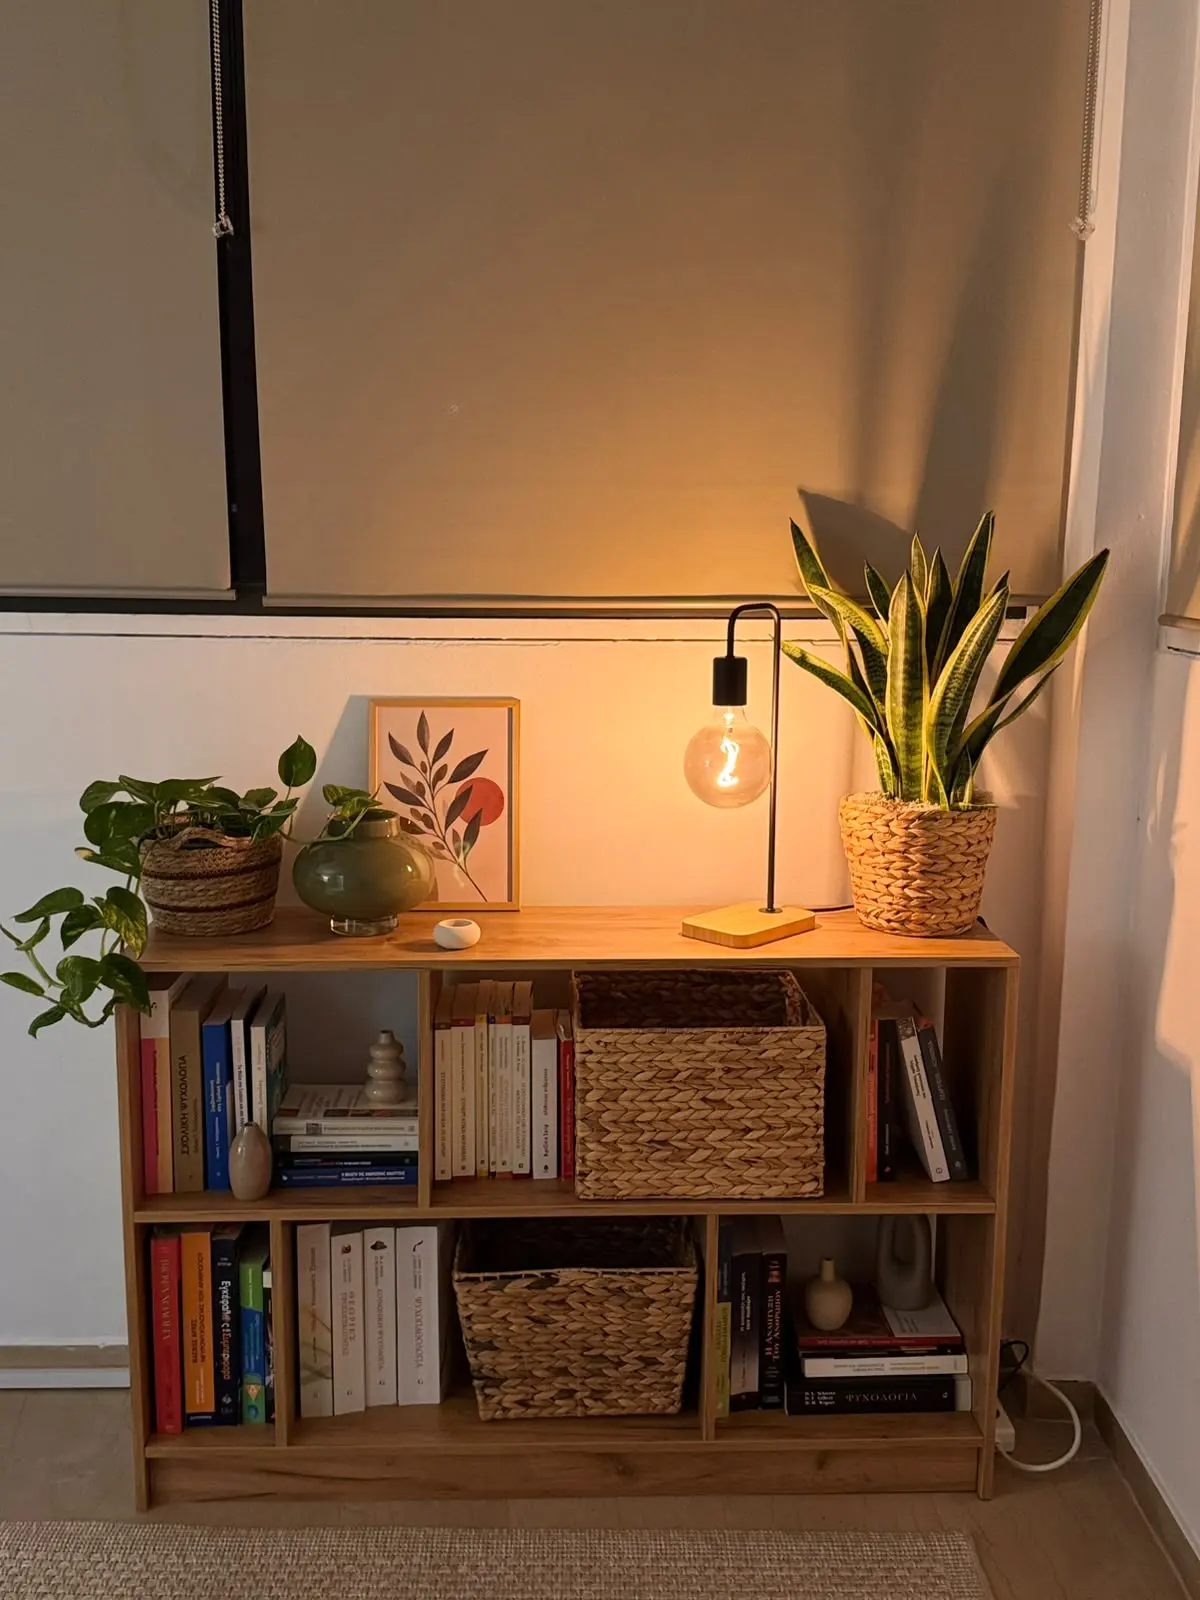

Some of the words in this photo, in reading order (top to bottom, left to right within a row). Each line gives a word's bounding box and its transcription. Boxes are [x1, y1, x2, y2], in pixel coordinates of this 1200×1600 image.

[177, 1055, 189, 1112] ΨΥΧΟΛΟΓΙΑ
[180, 1114, 190, 1156] ΣΧΟΛΙΚΗ
[765, 1295, 774, 1344] ΑΝΑΠΤΥΞΗ
[773, 1288, 781, 1339] ΑΝΘΡΩΠΟΥ
[764, 1347, 772, 1356] Η
[845, 1391, 918, 1402] ΨΥΧΟΛΟΓΙΑ
